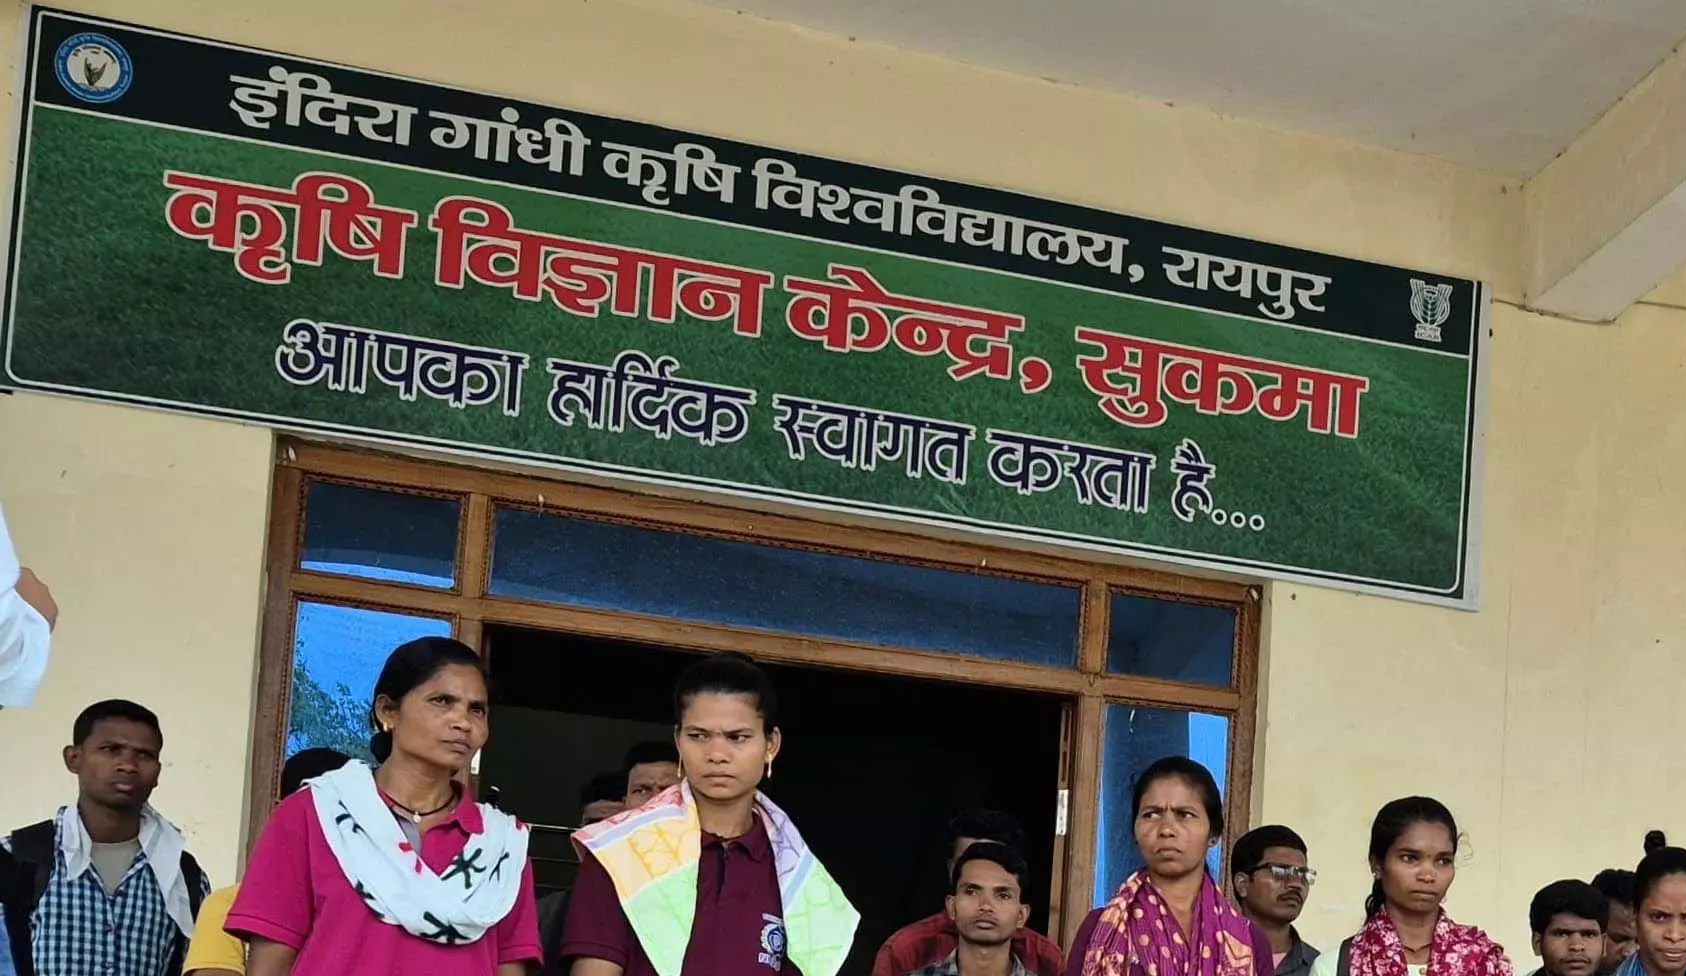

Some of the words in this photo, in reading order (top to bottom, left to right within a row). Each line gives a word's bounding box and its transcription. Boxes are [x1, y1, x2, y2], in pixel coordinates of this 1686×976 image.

[163, 170, 417, 287] कृषि
[432, 194, 773, 339] विज्ञान
[783, 263, 1054, 394] केन्द्र,
[1075, 325, 1370, 438] सुकमा
[229, 65, 417, 146] इंदिरा
[429, 106, 591, 177] गांधी
[602, 141, 741, 210] कृषि
[752, 157, 1147, 284] विश्वविद्यालय,
[1161, 245, 1332, 320] रायपुर
[275, 319, 529, 416] आपका
[546, 351, 757, 446] हार्दिक
[772, 394, 976, 486] स्वागत
[986, 429, 1156, 514] करता
